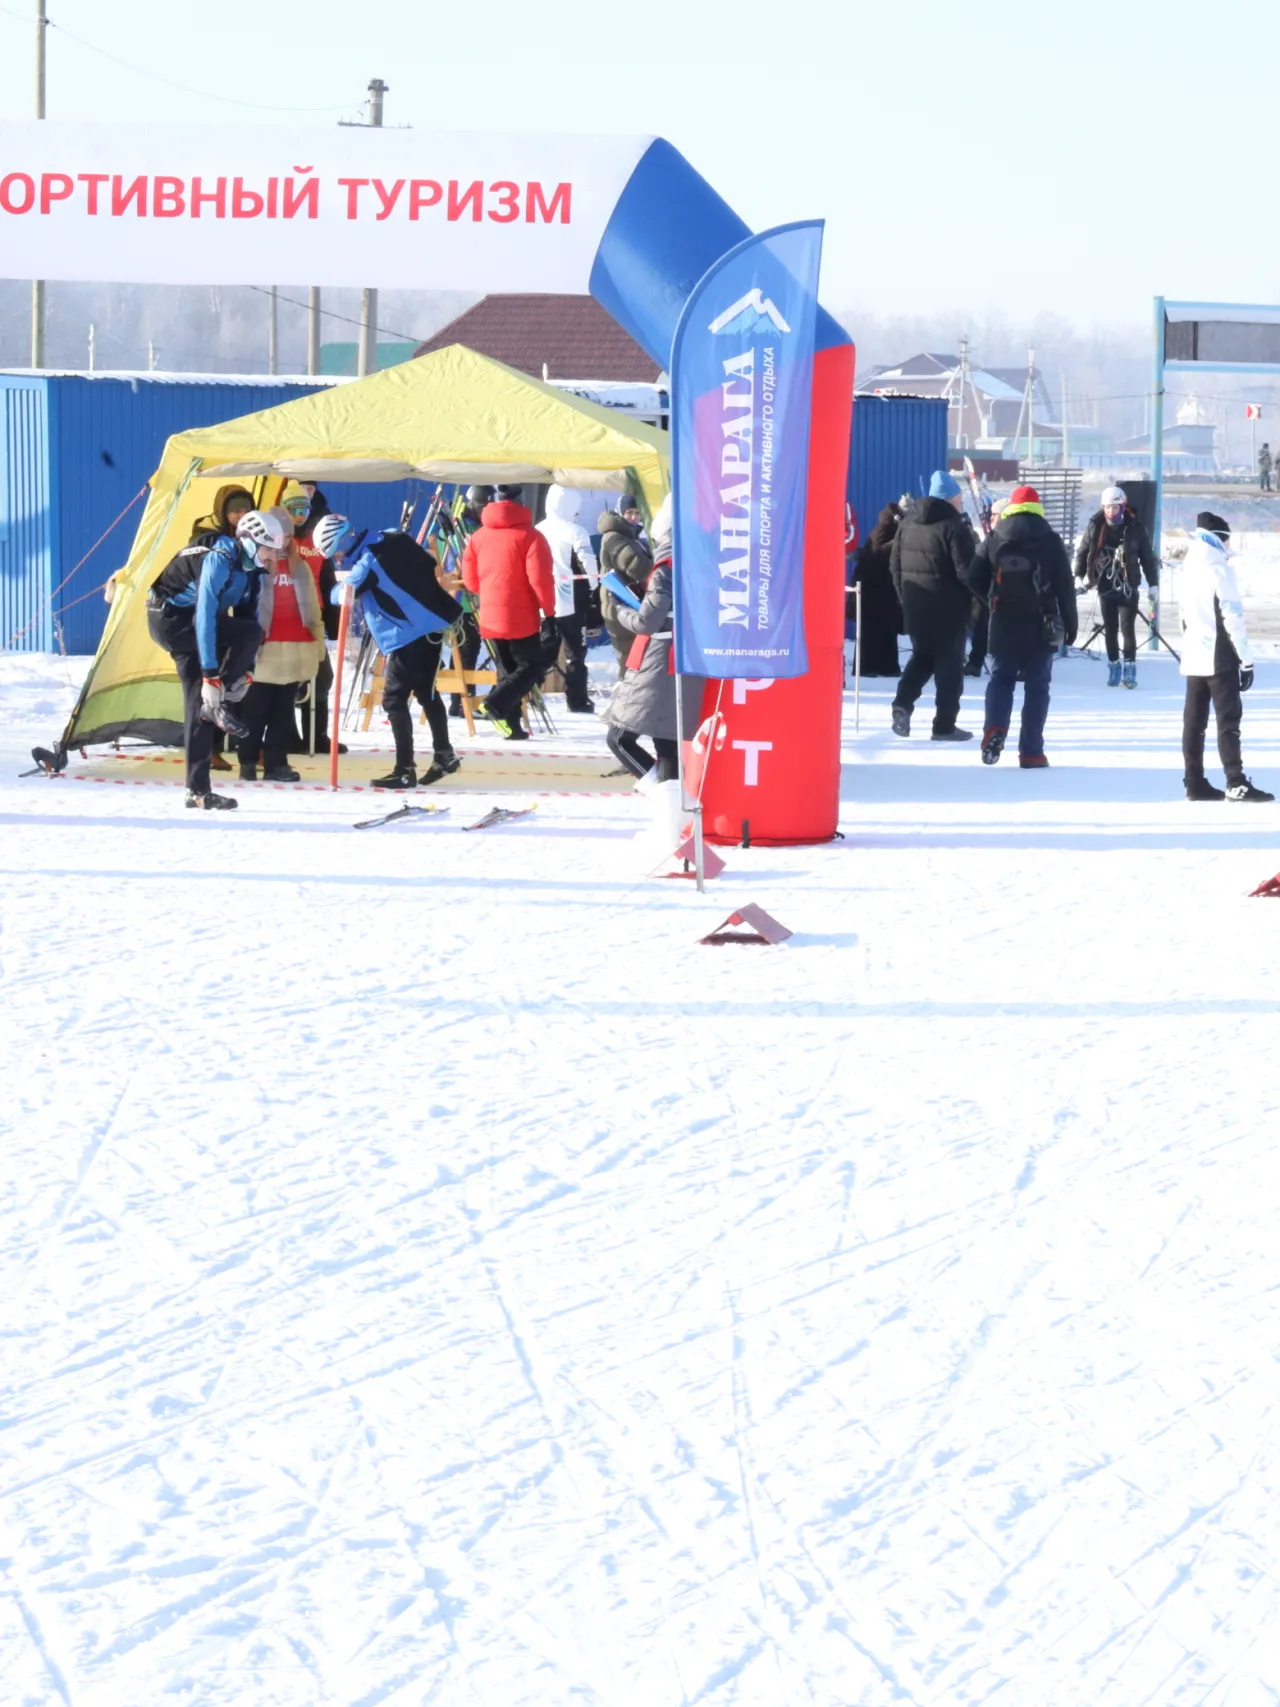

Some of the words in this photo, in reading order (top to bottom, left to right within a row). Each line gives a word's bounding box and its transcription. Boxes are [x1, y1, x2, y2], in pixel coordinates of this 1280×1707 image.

[0, 166, 319, 219] ОРТИВНЫЙ
[338, 178, 572, 224] ТУРИЗМ
[763, 347, 775, 401] ОТДЫХА
[762, 406, 774, 481] АКТИВНОГО
[718, 347, 754, 630] МАНАРАГА
[760, 483, 772, 493] И
[760, 496, 772, 545] СПОРТА
[760, 549, 772, 577] ДЛЯ
[758, 578, 770, 630] ТОВАРЫ
[703, 648, 790, 658] www.manaraga.ru
